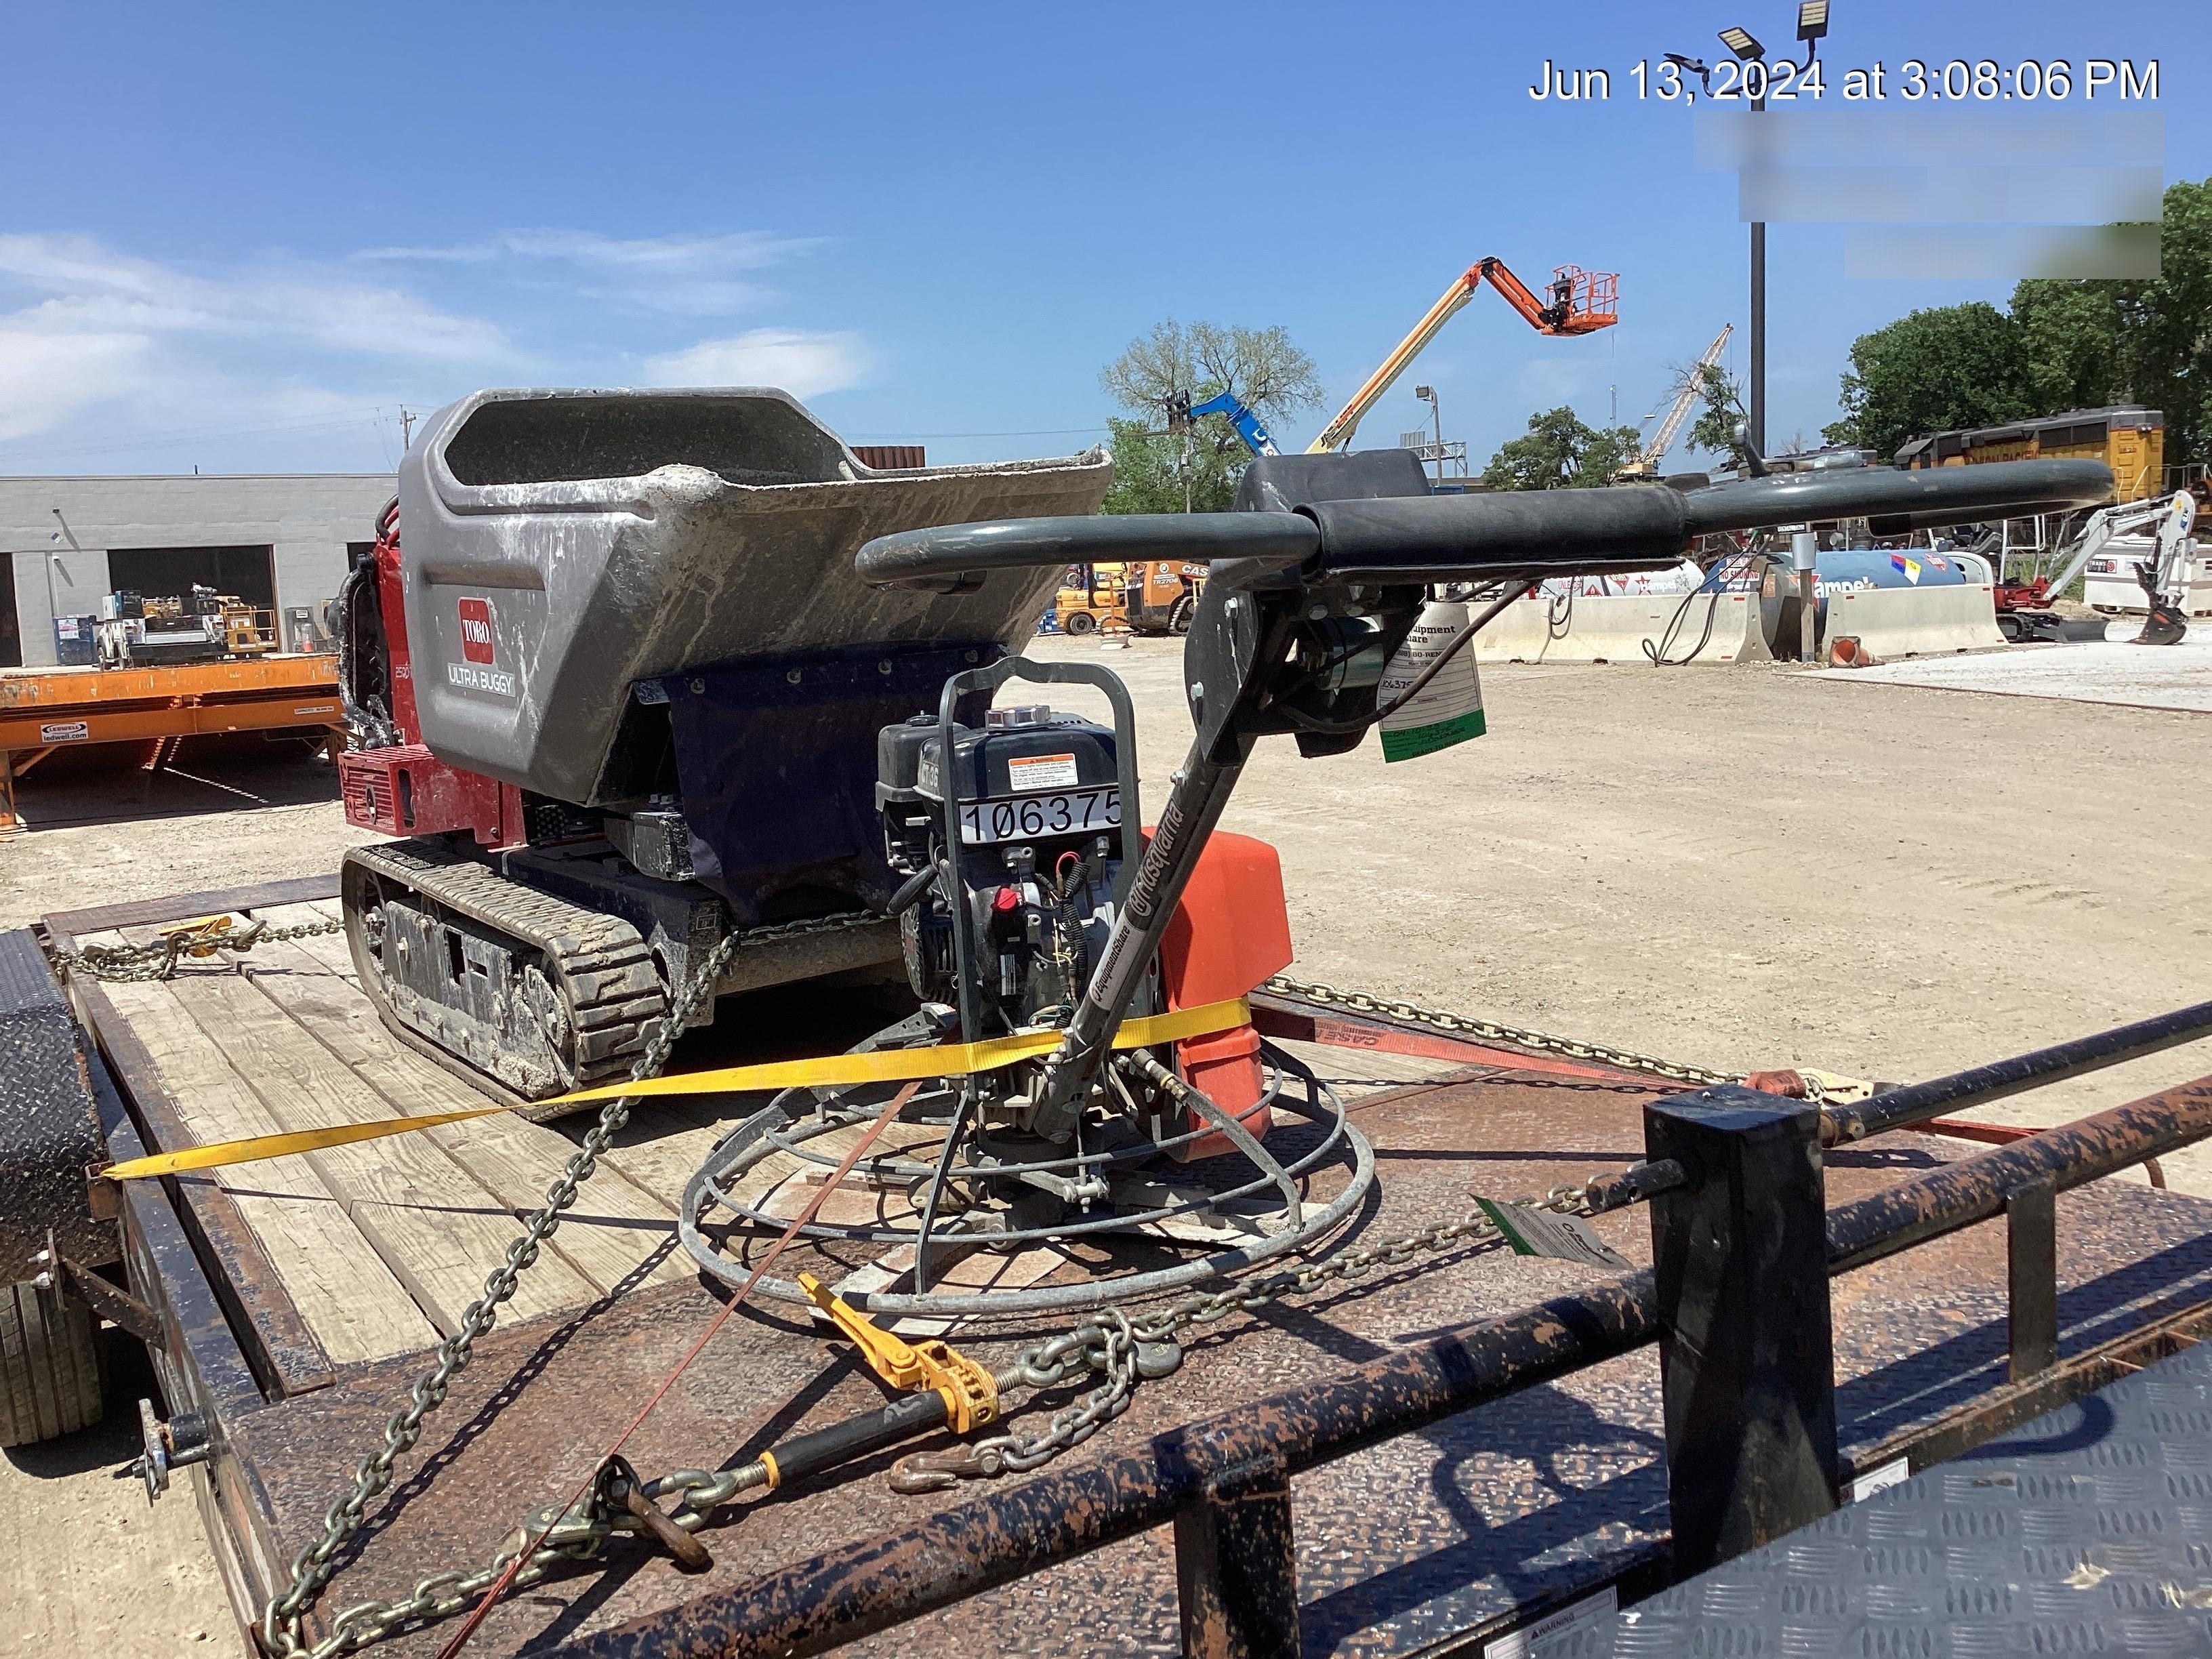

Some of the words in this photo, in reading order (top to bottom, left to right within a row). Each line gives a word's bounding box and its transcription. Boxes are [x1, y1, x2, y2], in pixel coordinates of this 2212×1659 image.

[1181, 564, 1209, 577] CAS
[462, 619, 490, 644] TORO
[1412, 624, 1456, 635] uipment
[448, 665, 479, 687] ULTRA
[480, 671, 512, 695] BUGGY
[43, 733, 87, 741] ledwell.com
[965, 790, 1122, 841] 106375
[1136, 798, 1185, 899] Husqvarna
[1096, 924, 1131, 994] EquipmentShare
